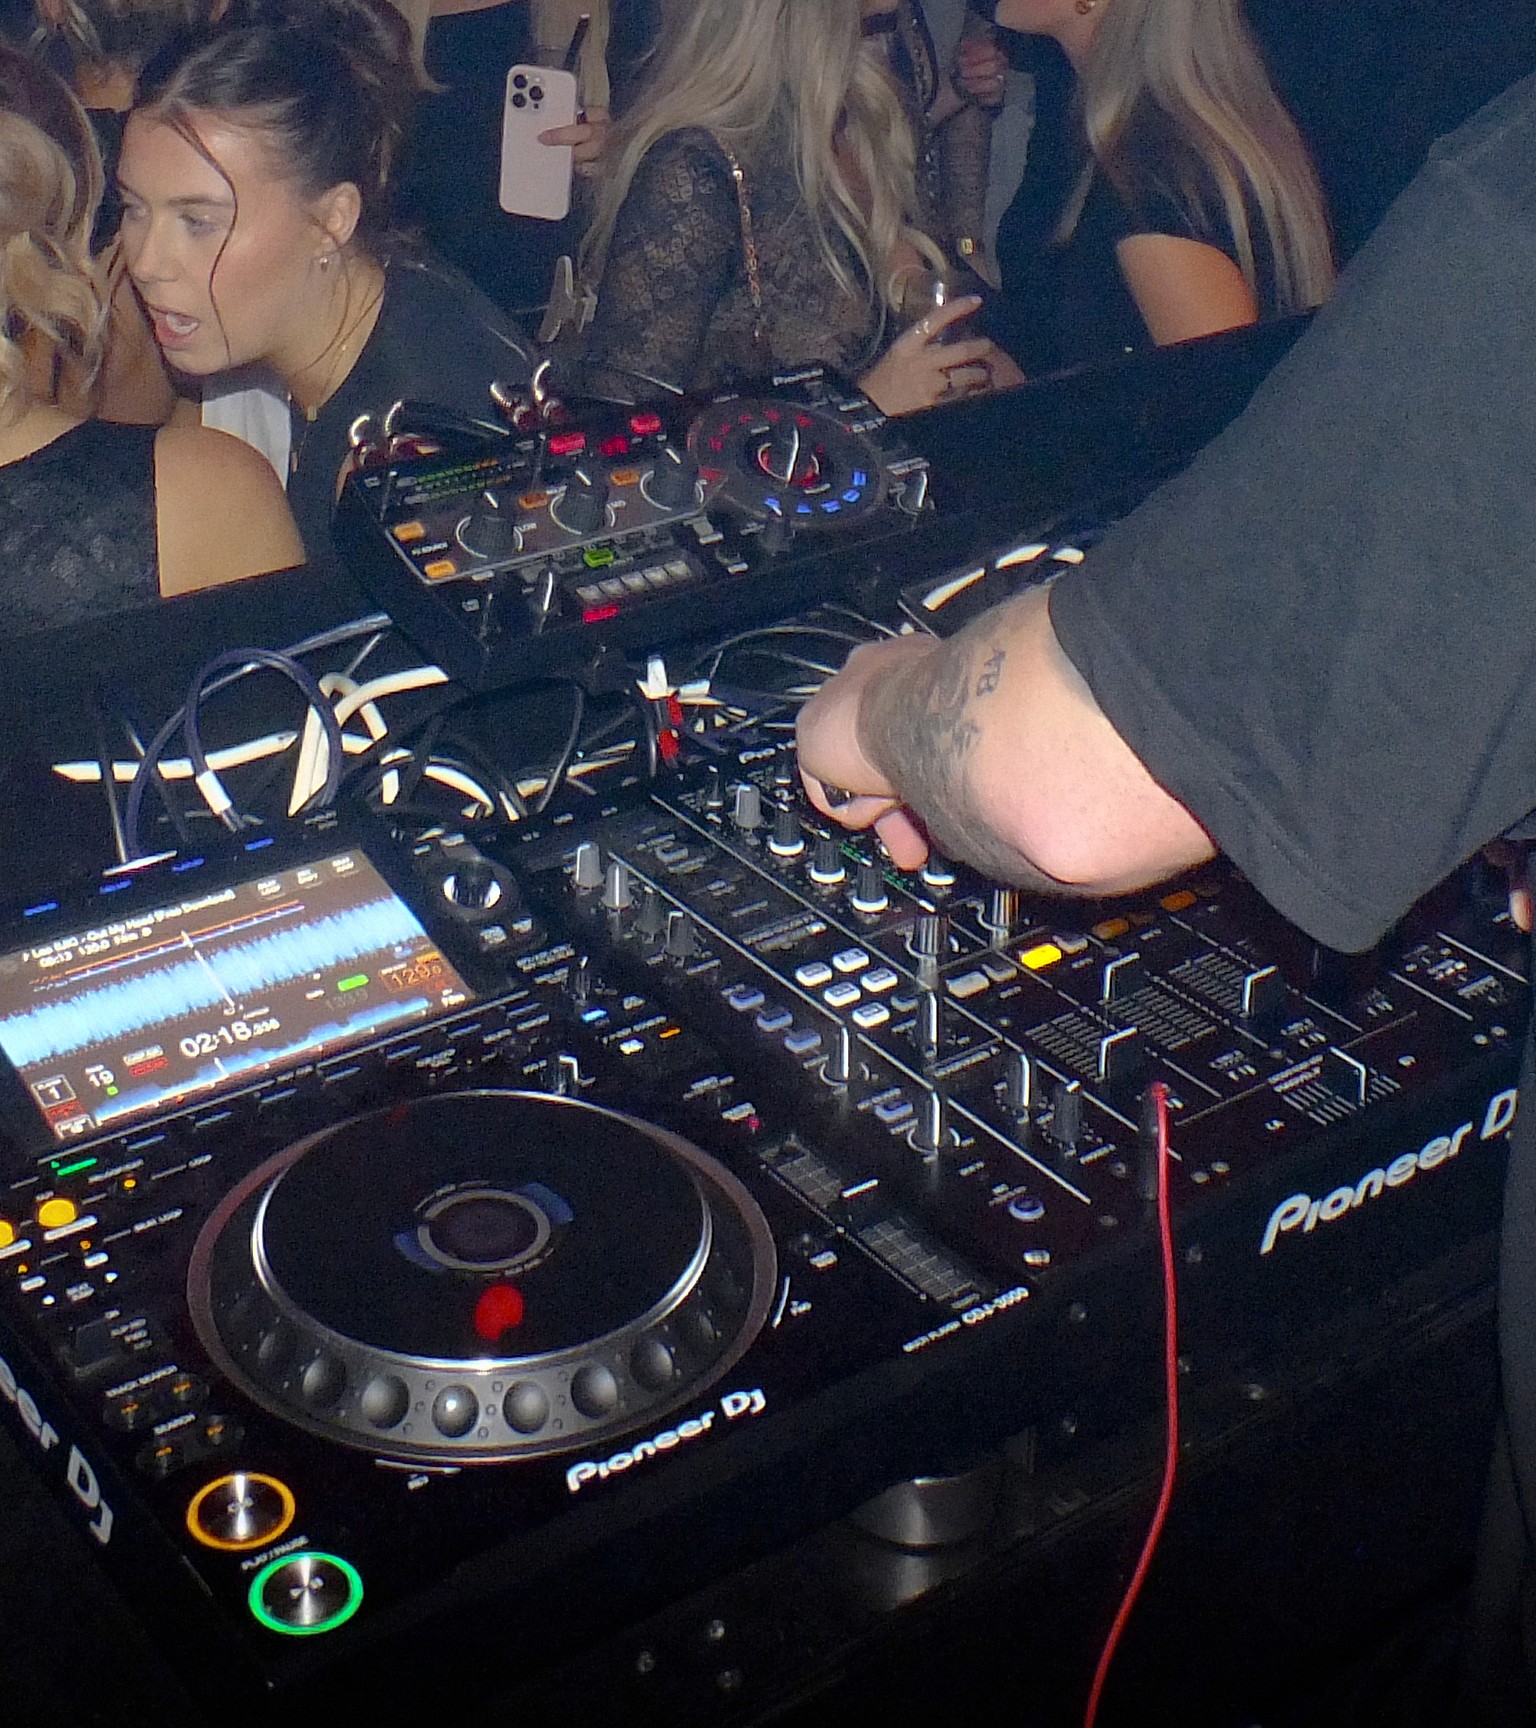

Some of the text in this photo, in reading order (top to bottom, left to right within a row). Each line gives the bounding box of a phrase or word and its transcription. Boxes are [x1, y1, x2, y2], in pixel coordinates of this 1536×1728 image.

[88, 1070, 115, 1089] 19
[1259, 1087, 1519, 1256] Pioneer D
[565, 1410, 716, 1493] Pioneer
